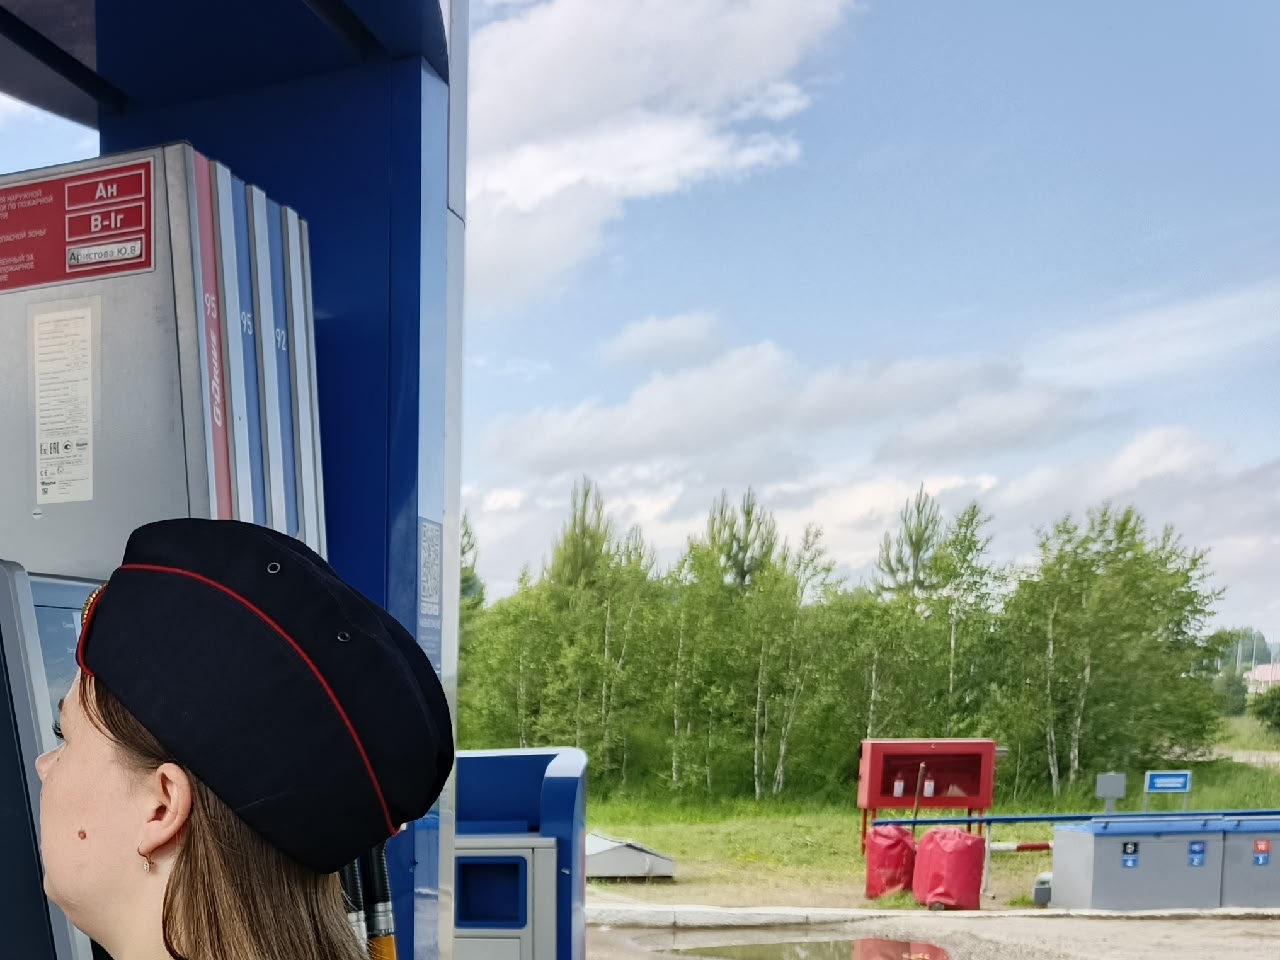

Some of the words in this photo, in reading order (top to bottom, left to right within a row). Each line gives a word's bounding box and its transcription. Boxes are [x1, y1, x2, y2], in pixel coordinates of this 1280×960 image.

[95, 182, 118, 200] Ан
[204, 293, 218, 319] 95
[241, 311, 253, 336] 95
[275, 328, 287, 351] 92
